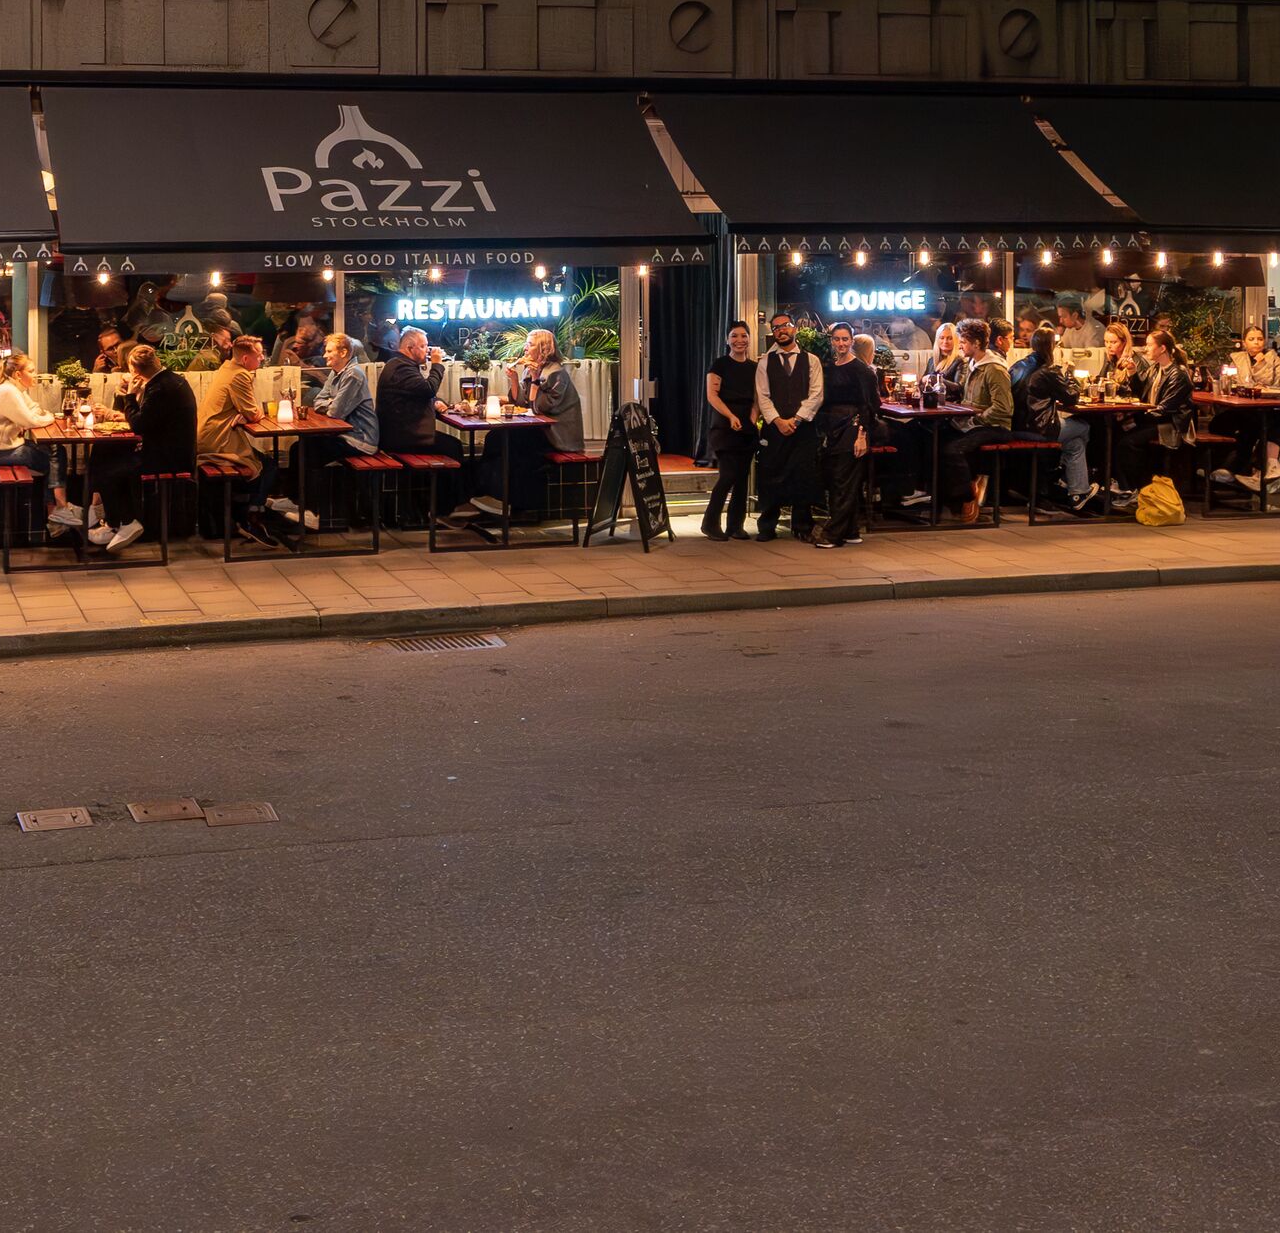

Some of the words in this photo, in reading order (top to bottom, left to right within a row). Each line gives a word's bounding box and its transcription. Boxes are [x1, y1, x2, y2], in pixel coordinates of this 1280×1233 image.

[261, 166, 496, 212] Pazzi
[311, 217, 466, 228] STOCKHOLM
[264, 255, 314, 268] SLOW
[323, 254, 335, 266] &
[343, 253, 395, 266] GOOD
[405, 253, 476, 265] ITALIAN
[486, 252, 535, 264] FOOD
[398, 297, 564, 320] RESTAURANT
[831, 290, 926, 312] LOUNGE
